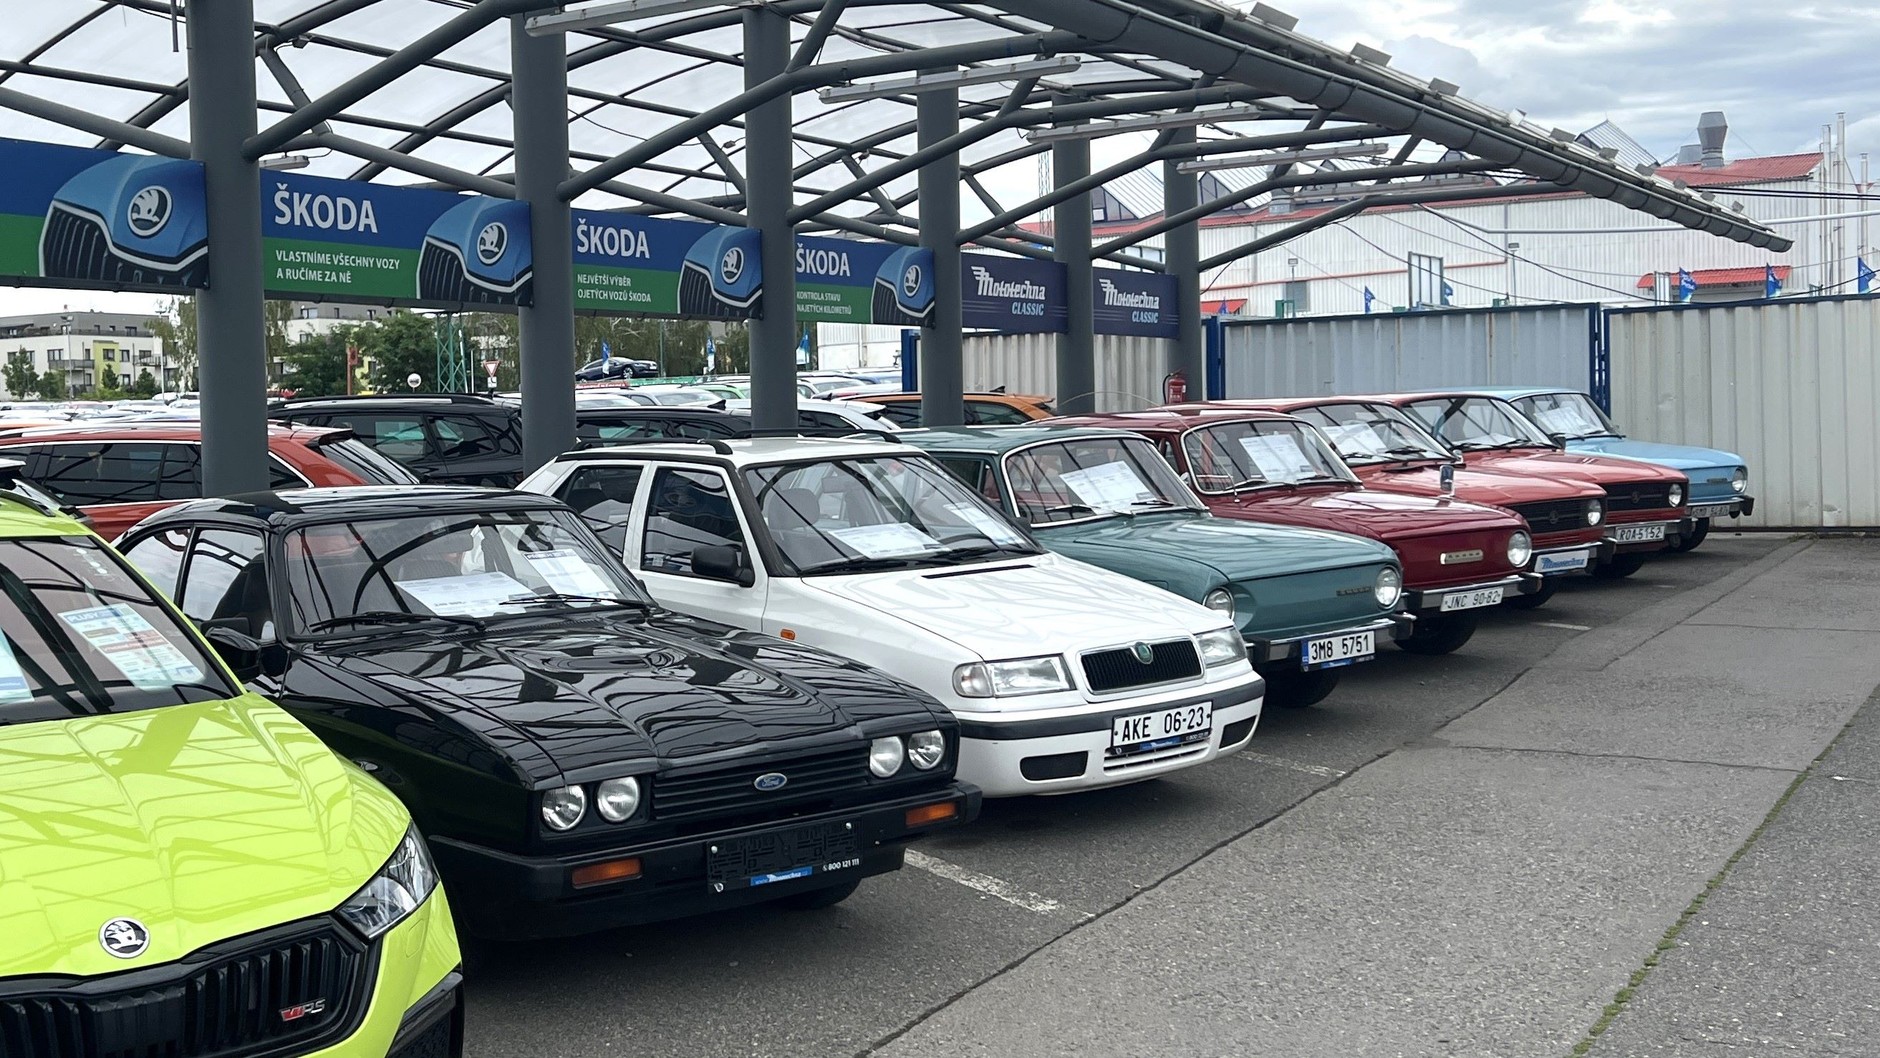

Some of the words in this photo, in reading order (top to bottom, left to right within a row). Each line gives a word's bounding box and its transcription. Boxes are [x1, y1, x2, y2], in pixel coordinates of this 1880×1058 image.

[274, 182, 378, 233] ŠKODA
[576, 217, 650, 259] ŠKODA
[275, 249, 331, 265] VLASTNÍME
[332, 252, 375, 268] VŠECHNY
[375, 258, 400, 270] VOZY
[796, 242, 851, 277] ŠKODA
[276, 267, 284, 279] A
[285, 267, 323, 281] RUČÍME
[324, 270, 338, 282] ZA
[339, 270, 352, 283] NĚ
[577, 273, 609, 285] NEJVĚTŠÍ
[609, 275, 632, 287] VÝBĚR
[970, 265, 1046, 300] Mototechna
[577, 288, 609, 300] OJETÝCH
[609, 290, 628, 301] VOZŮ
[628, 291, 652, 303] ŠKODA
[1099, 278, 1160, 309] Mototechna
[1011, 301, 1045, 316] CLASSIC
[1132, 310, 1159, 324] CLASSIC
[1447, 594, 1468, 609] JNC
[1311, 640, 1333, 661] 3M8
[1341, 633, 1369, 656] 5751
[1122, 716, 1151, 742] AKE
[1163, 706, 1204, 734] 06-23
